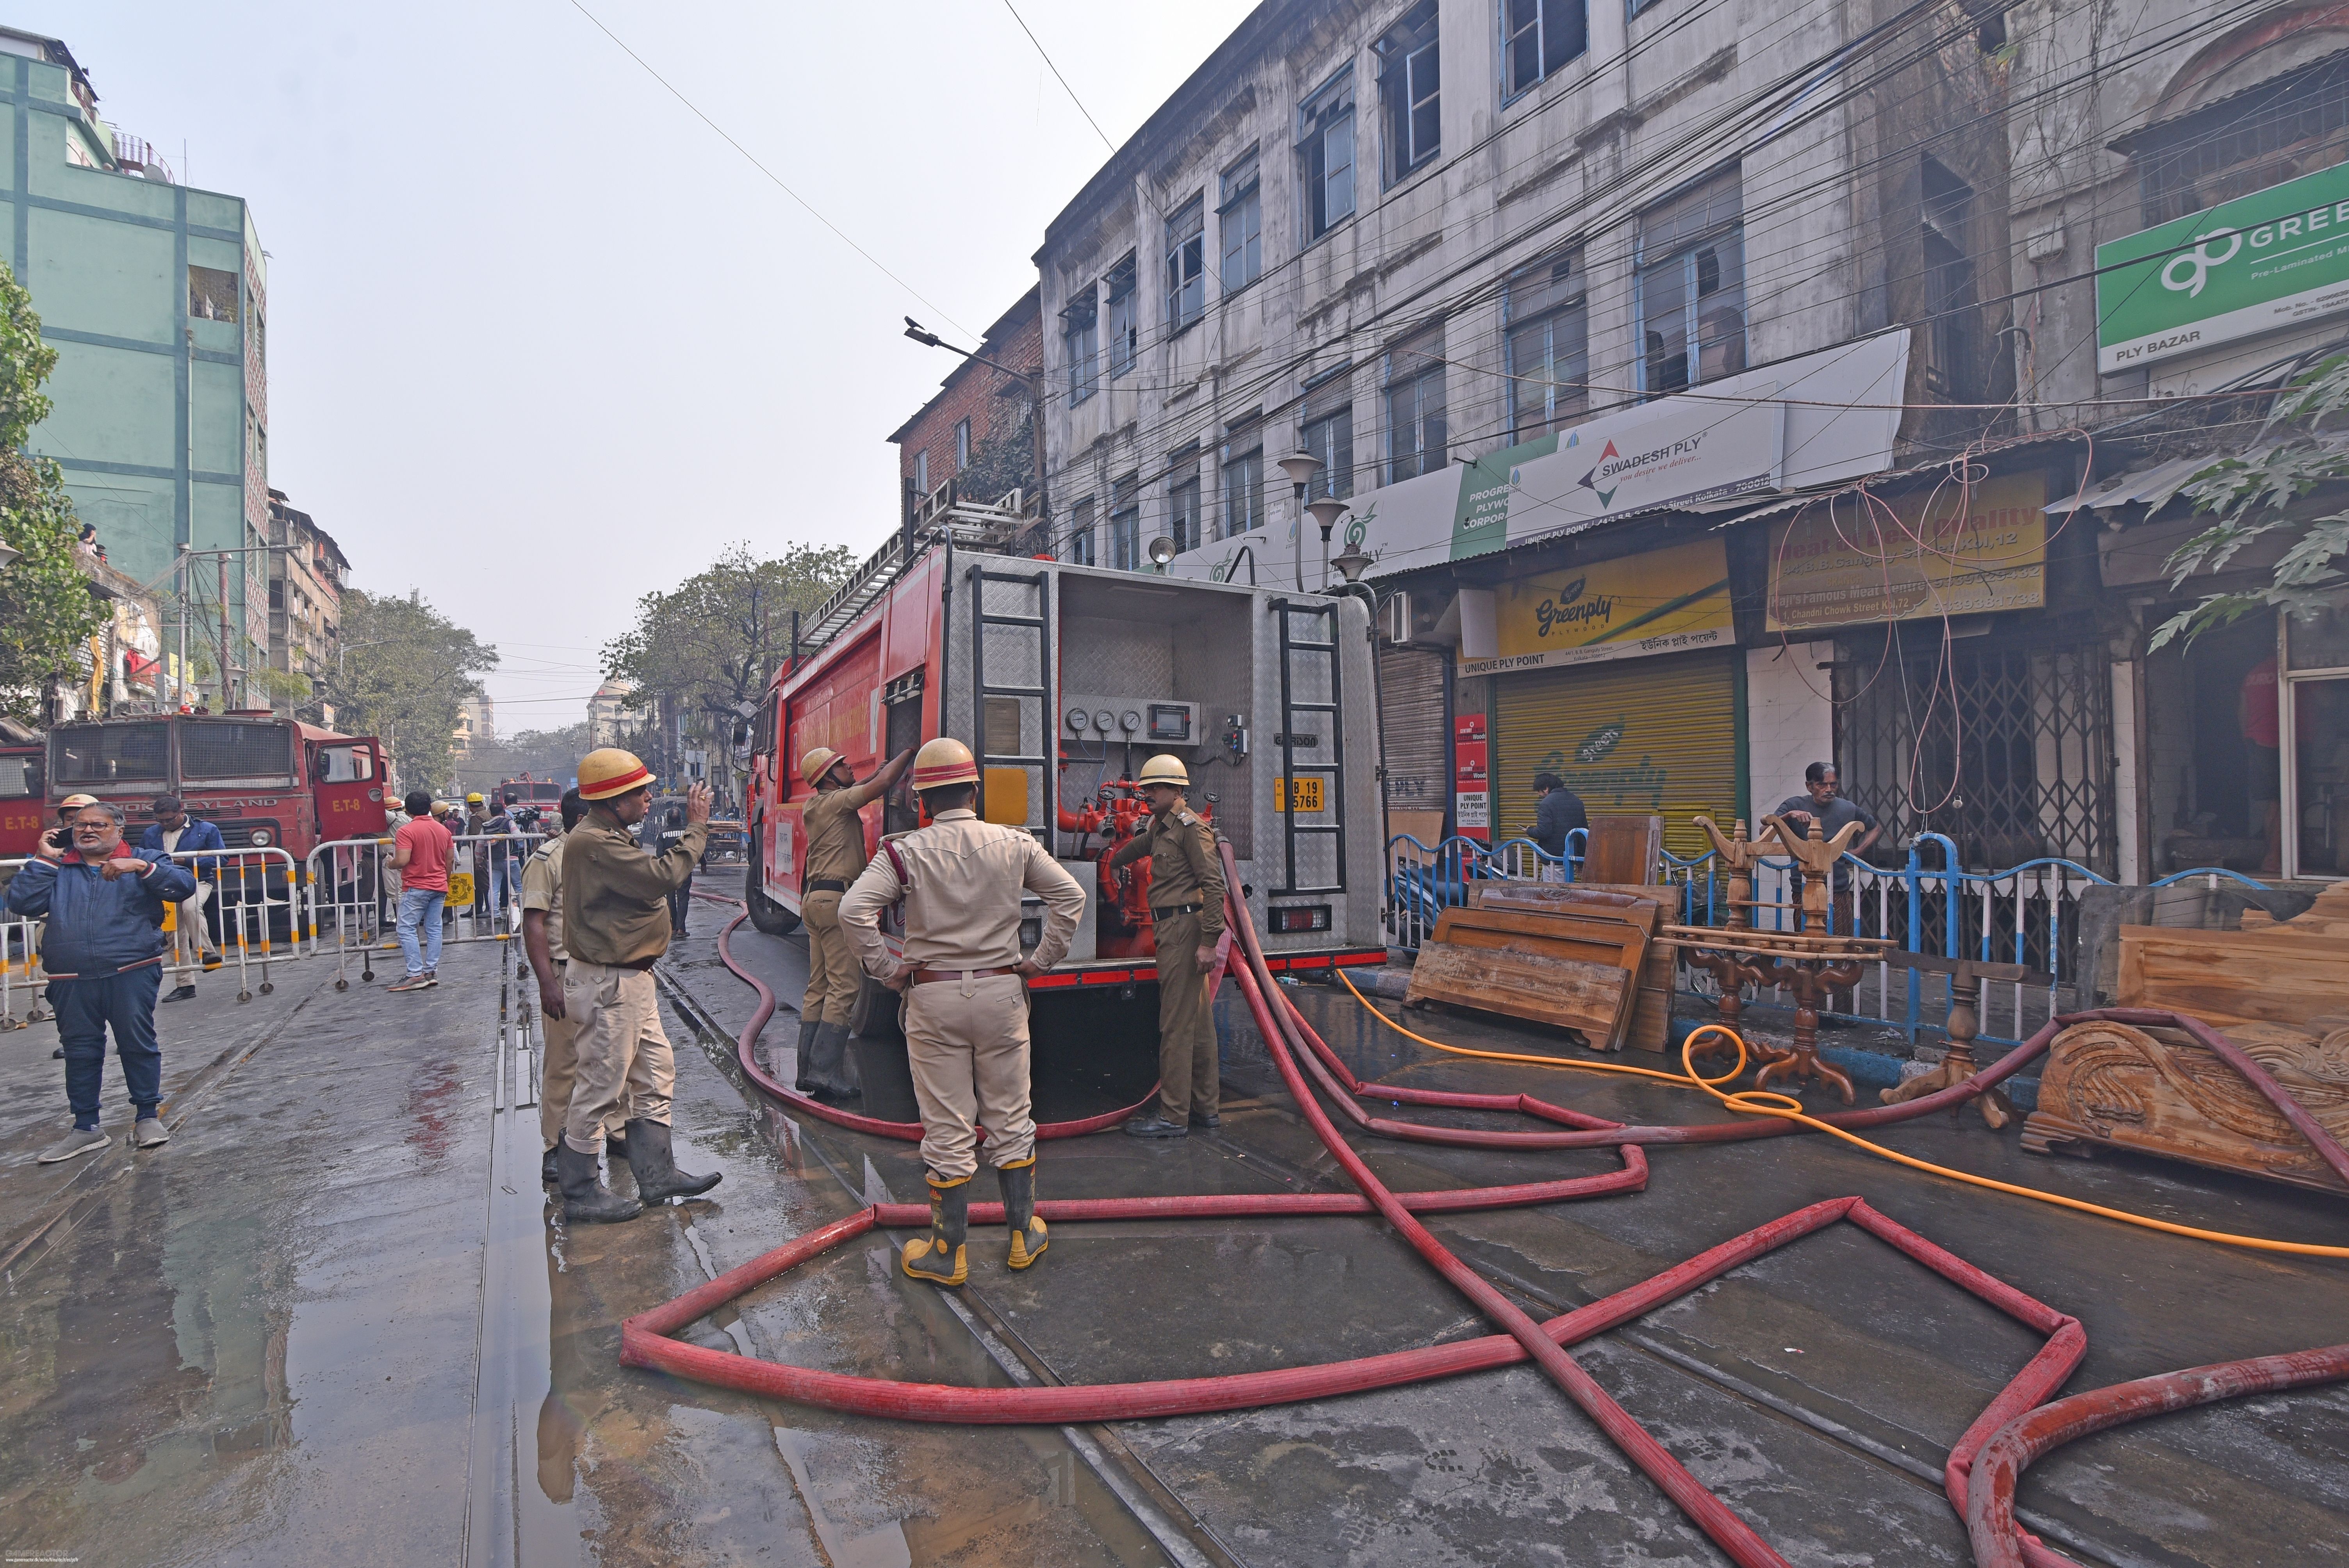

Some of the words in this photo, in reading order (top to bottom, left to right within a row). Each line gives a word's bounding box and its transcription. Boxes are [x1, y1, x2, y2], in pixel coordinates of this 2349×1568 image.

[2251, 250, 2333, 280] Pre-Laminated
[2116, 346, 2142, 362] PLY
[2147, 330, 2201, 353] BAZAR
[1602, 447, 1670, 476] SWADESH
[1674, 437, 1702, 456] PLY
[1618, 474, 1633, 484] you
[1634, 467, 1656, 479] desire
[1658, 463, 1668, 471] we
[1669, 455, 1702, 468] deliver...
[1552, 529, 1565, 538] PLY
[1566, 523, 1589, 534] POINT
[1668, 496, 1693, 508] Street
[1695, 486, 1728, 503] Kolkata
[1735, 476, 1771, 492] 700012
[1773, 538, 1830, 561] Meat
[1866, 521, 1926, 548] Best
[1933, 506, 2038, 539] Quality
[1826, 573, 1863, 587] BRANCH
[1803, 590, 1846, 604] Famous
[1850, 583, 1880, 598] Meat
[1883, 580, 1925, 594] Centre
[1535, 595, 1612, 638] Greenply
[1792, 607, 1822, 619] Chandni
[1824, 603, 1851, 615] Chowk
[1854, 599, 1879, 611] Street
[1882, 598, 1909, 611] Kol,72
[1551, 624, 1605, 636] PLYWOOD
[1639, 637, 1670, 651] ইউনিক
[1671, 634, 1689, 647] প্লাই
[1690, 630, 1718, 643] পয়েন্ট
[1465, 660, 1498, 674] UNIQUE
[1499, 657, 1513, 669] PLY
[1516, 654, 1545, 666] POINT
[1306, 781, 1318, 794] 19
[184, 799, 278, 810] EYLAND
[332, 798, 360, 813] E.T-8
[1293, 795, 1318, 808] 5766
[5, 816, 39, 830] E.T-8
